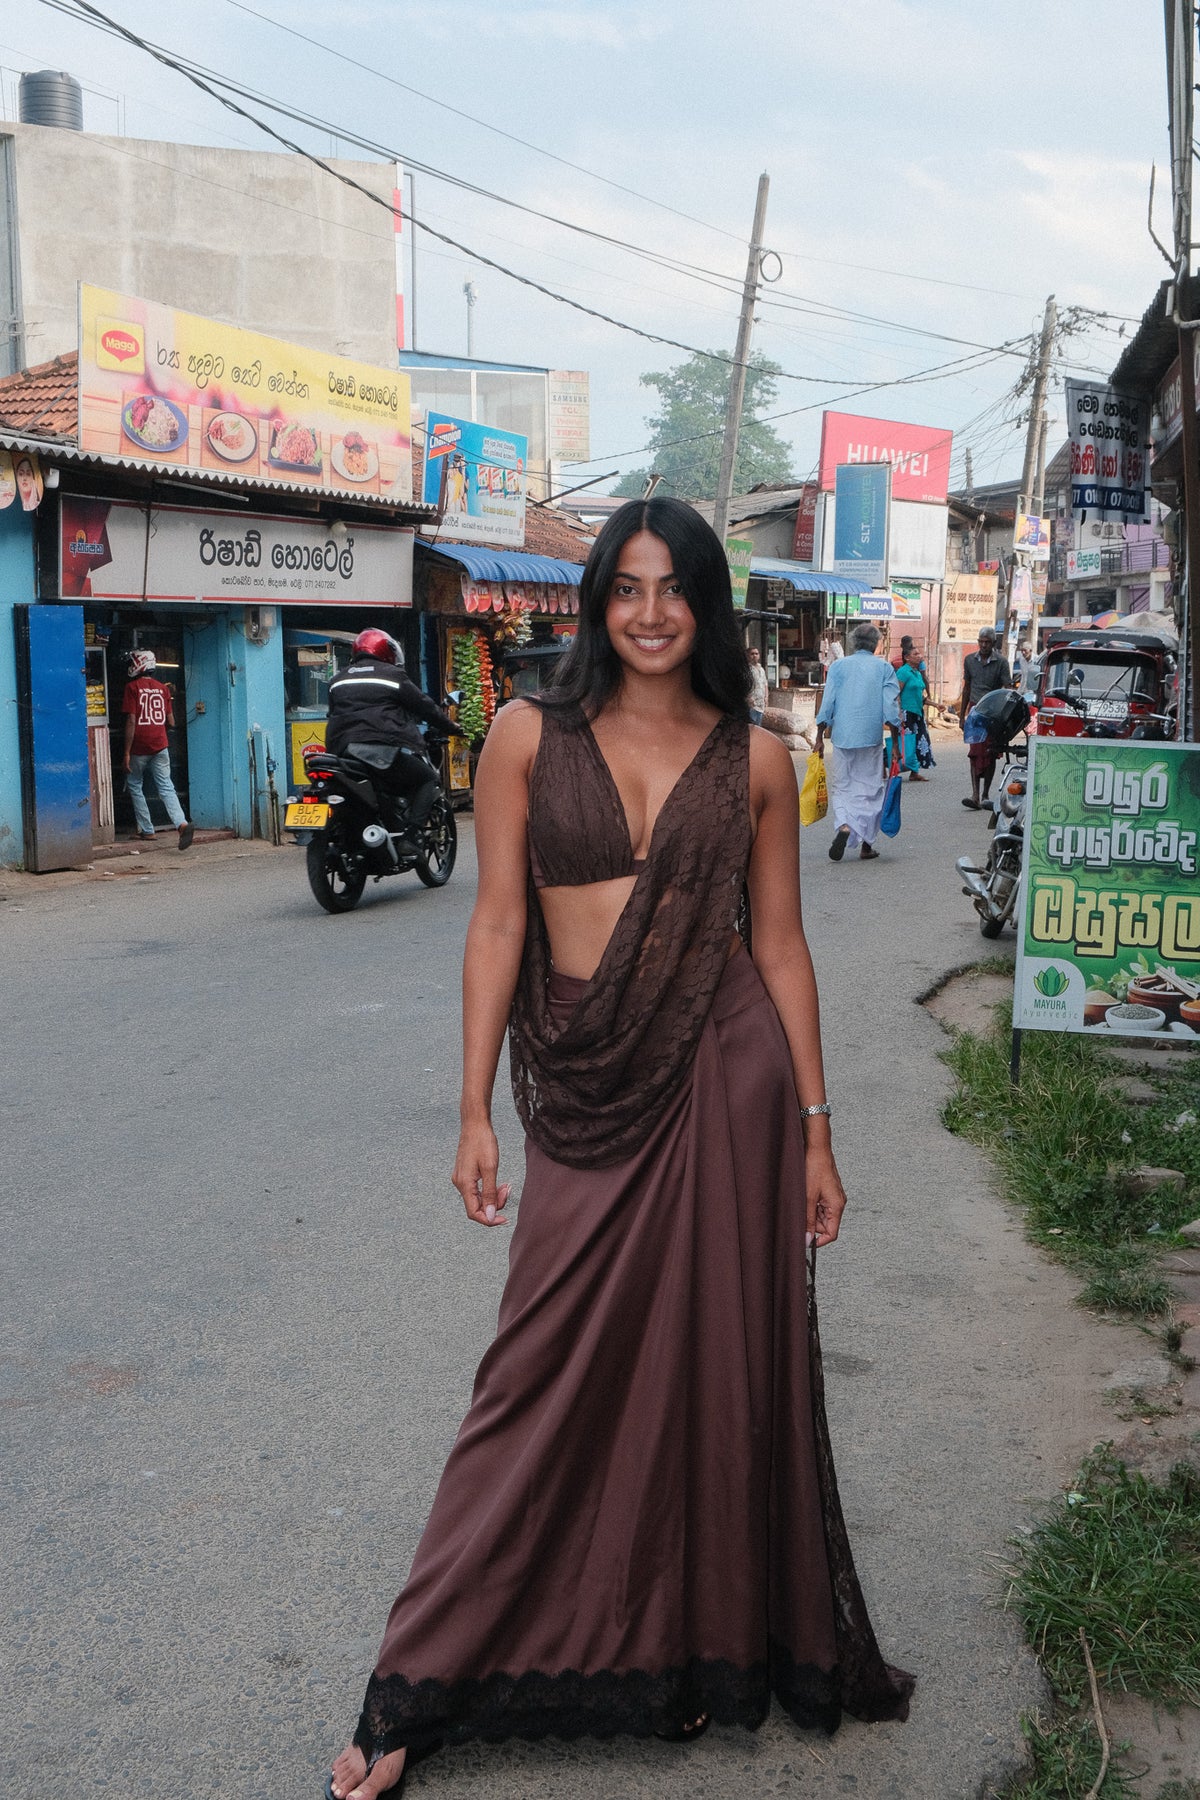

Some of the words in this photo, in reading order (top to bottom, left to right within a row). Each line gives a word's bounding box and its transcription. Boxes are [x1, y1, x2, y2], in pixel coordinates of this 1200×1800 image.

[105, 336, 136, 353] Maggi
[847, 443, 928, 477] HUAWEI
[199, 528, 261, 568] රිෂාඩ්
[271, 538, 354, 580] හොටෙල්
[863, 601, 889, 610] NOKIA
[138, 693, 166, 725] 18
[1085, 762, 1168, 814] මයුර
[298, 805, 320, 815] BLF
[293, 815, 321, 825] 5047
[1034, 999, 1067, 1011] MAYURA
[1023, 1008, 1079, 1021] Ayurvedic
